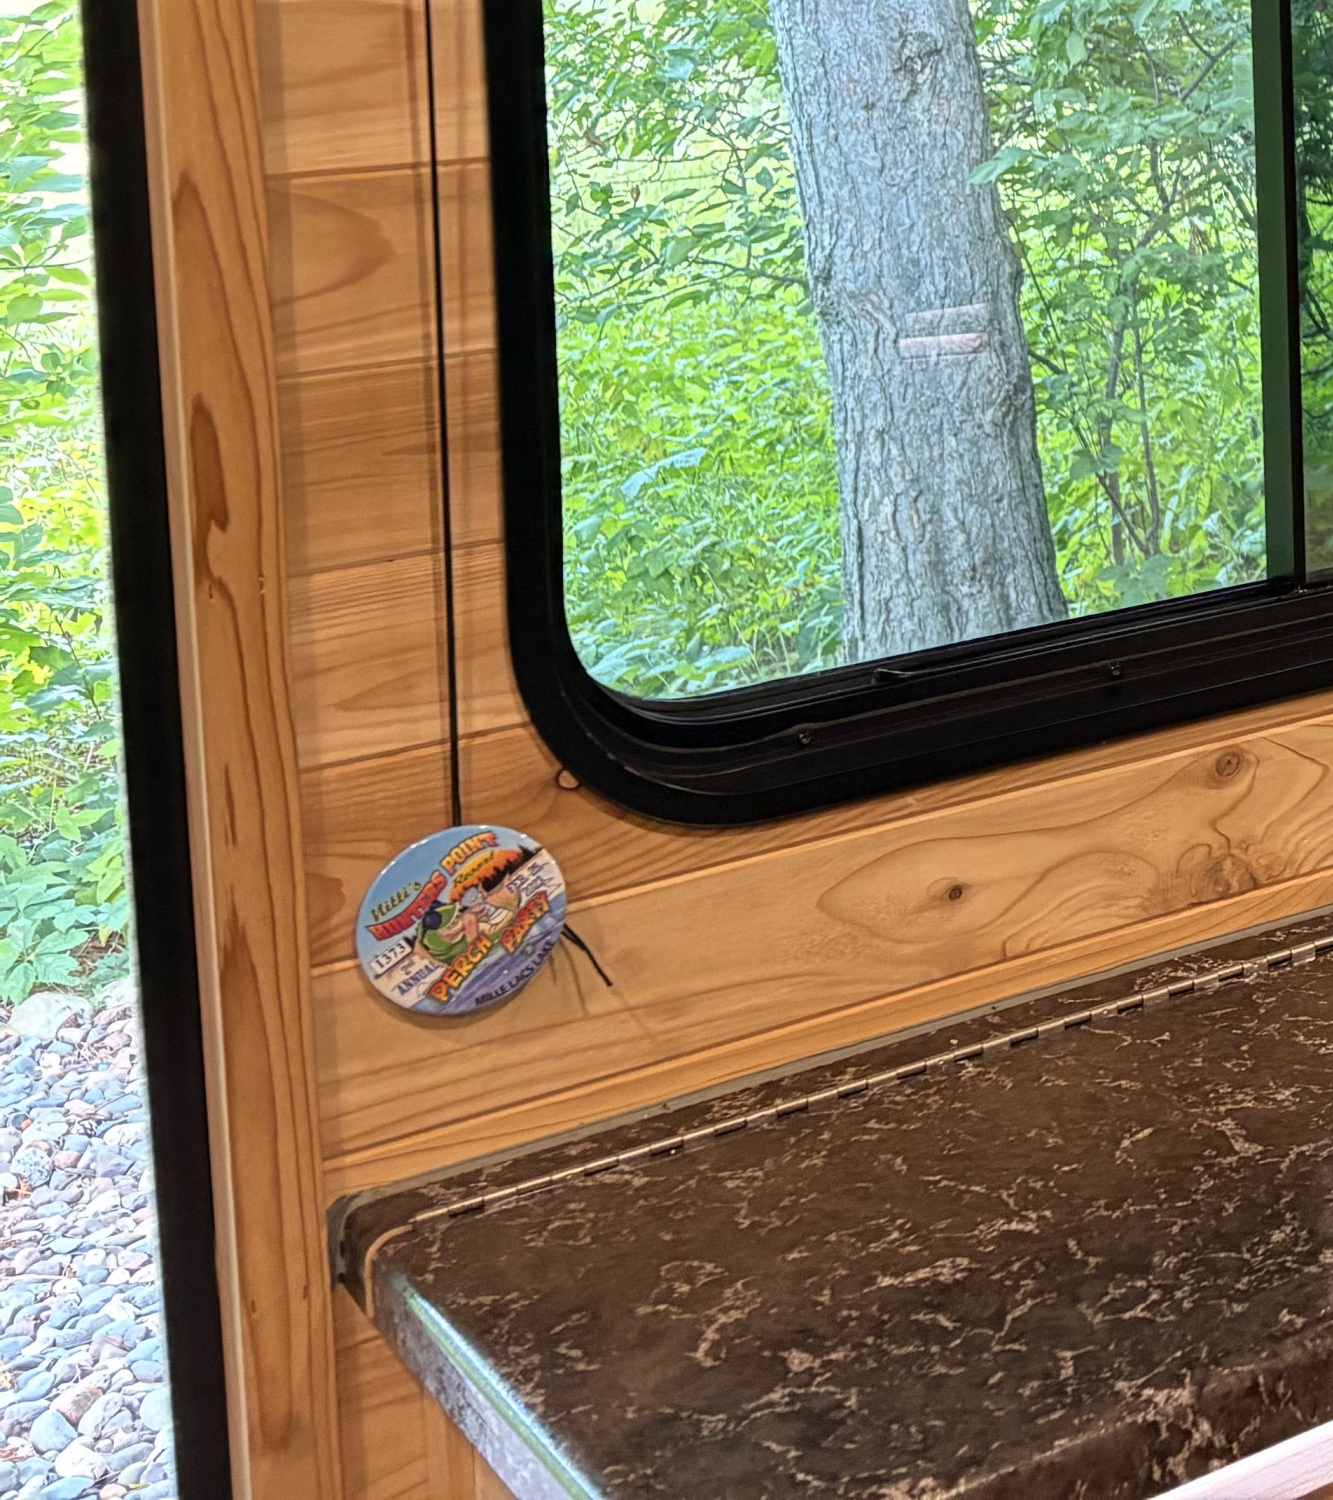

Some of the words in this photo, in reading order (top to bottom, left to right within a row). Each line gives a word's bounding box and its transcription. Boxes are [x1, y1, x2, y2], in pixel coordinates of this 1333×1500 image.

[440, 831, 499, 876] POINT
[375, 943, 406, 968] 1373
[428, 934, 492, 1002] PERCH
[501, 890, 550, 953] PARTY
[396, 961, 441, 995] ANNUAL
